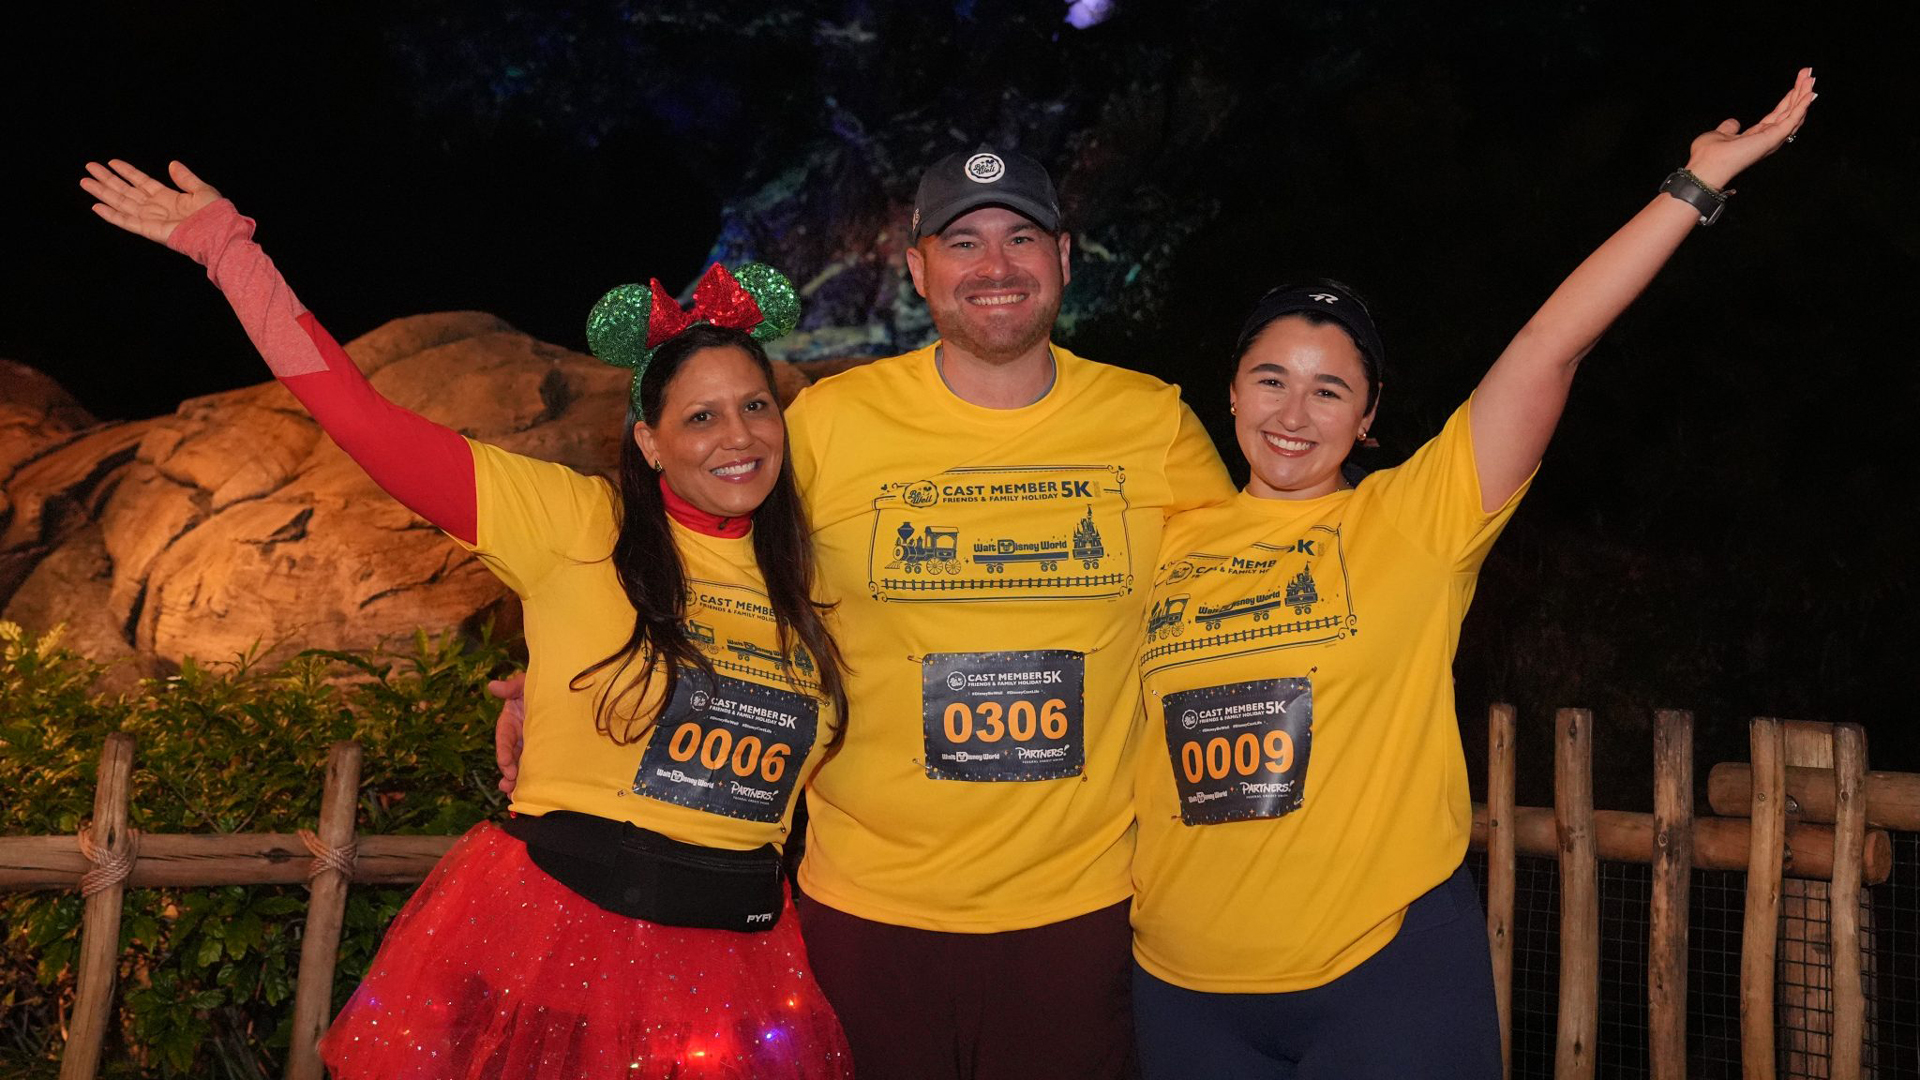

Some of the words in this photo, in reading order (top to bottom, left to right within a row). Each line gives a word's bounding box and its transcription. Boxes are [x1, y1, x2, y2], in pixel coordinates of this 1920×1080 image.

[943, 485, 985, 496] CAST
[991, 481, 1058, 494] MEMBER
[1061, 480, 1093, 498] 5K
[1021, 493, 1058, 501] HOLIDAY
[911, 494, 932, 505] Well
[973, 542, 996, 553] Walt
[997, 539, 1040, 555] Disney
[1040, 540, 1068, 550] World
[1228, 567, 1257, 575] FAMILY
[1231, 557, 1278, 569] MEMB
[700, 594, 733, 607] CAST
[735, 600, 775, 617] MEMBE
[1255, 591, 1281, 604] World
[699, 602, 726, 612] FRIENDS
[733, 609, 755, 618] FAMILY
[756, 614, 776, 623] HOLID
[967, 673, 996, 682] CAST
[998, 672, 1042, 681] MEMBER
[1043, 670, 1062, 684] 5K
[708, 705, 731, 715] FRIENDS
[736, 711, 755, 720] FAMILY
[755, 715, 778, 725] HOLIDAY
[710, 697, 738, 710] CAST
[739, 703, 779, 720] MEMBER
[777, 713, 798, 730] 5K
[1199, 708, 1223, 719] CAST
[1224, 702, 1265, 715] MEMBER
[1265, 700, 1287, 715] 5K
[943, 698, 1068, 743] 0306
[668, 722, 791, 782] 0006
[1181, 729, 1294, 784] 0009
